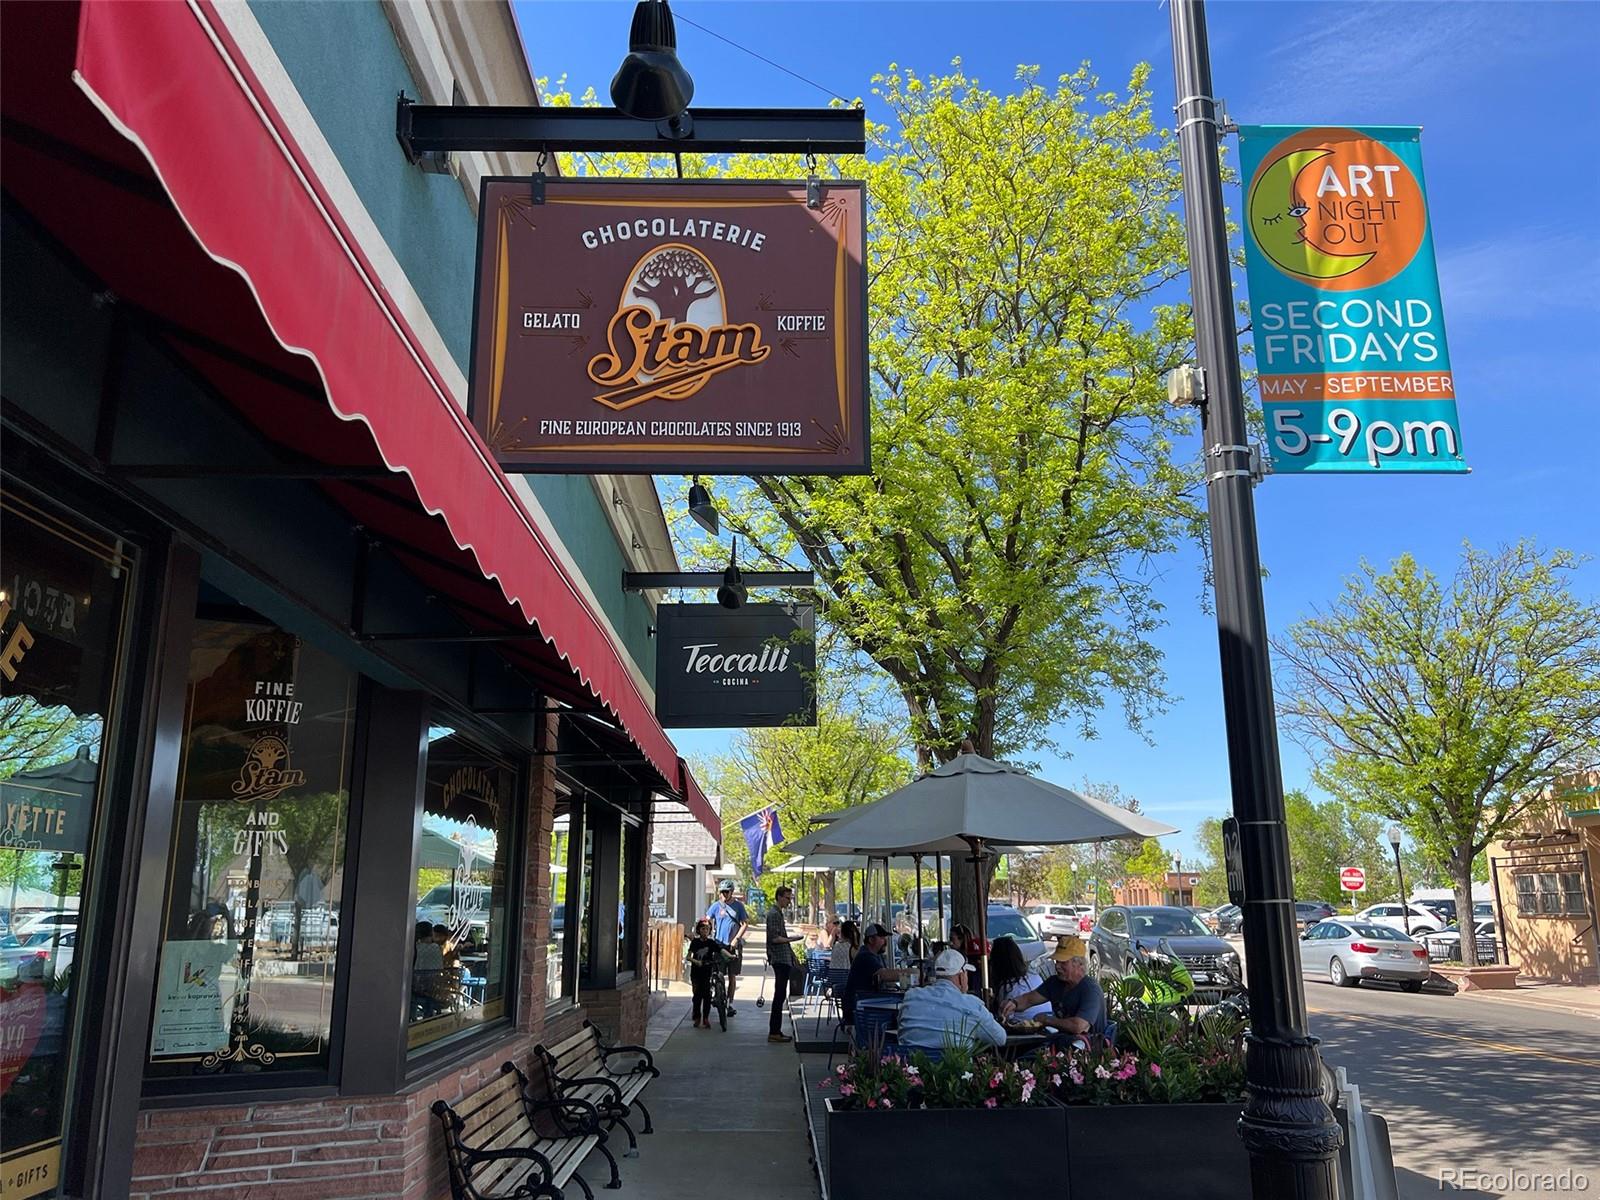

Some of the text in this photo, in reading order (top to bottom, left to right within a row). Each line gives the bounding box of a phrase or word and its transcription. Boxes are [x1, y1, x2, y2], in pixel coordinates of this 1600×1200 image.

[1316, 164, 1400, 198] ART
[1317, 200, 1400, 221] NIGHT
[581, 217, 767, 252] CHOCOLATERIE
[1322, 222, 1383, 244] OUT
[523, 312, 581, 330] GELATO
[776, 314, 826, 332] KOFFIE
[1261, 299, 1432, 331] SECOND
[587, 304, 771, 392] Stam
[1264, 332, 1438, 365] FRIDAYS
[1261, 378, 1308, 396] MAY
[1327, 376, 1453, 394] SEPTEMBER
[539, 419, 802, 437] FINE EUROPEAN CHOCOLATES SINCE 1913
[1272, 408, 1458, 470] 5-9pm
[682, 643, 791, 673] Teocalli
[255, 681, 294, 696] FINE
[722, 678, 749, 686] COCINA
[245, 698, 303, 725] KOFFIE
[231, 761, 307, 796] Stam
[246, 809, 280, 826] AND
[233, 829, 288, 857] GIFTS
[16, 1164, 48, 1188] GIFTS
